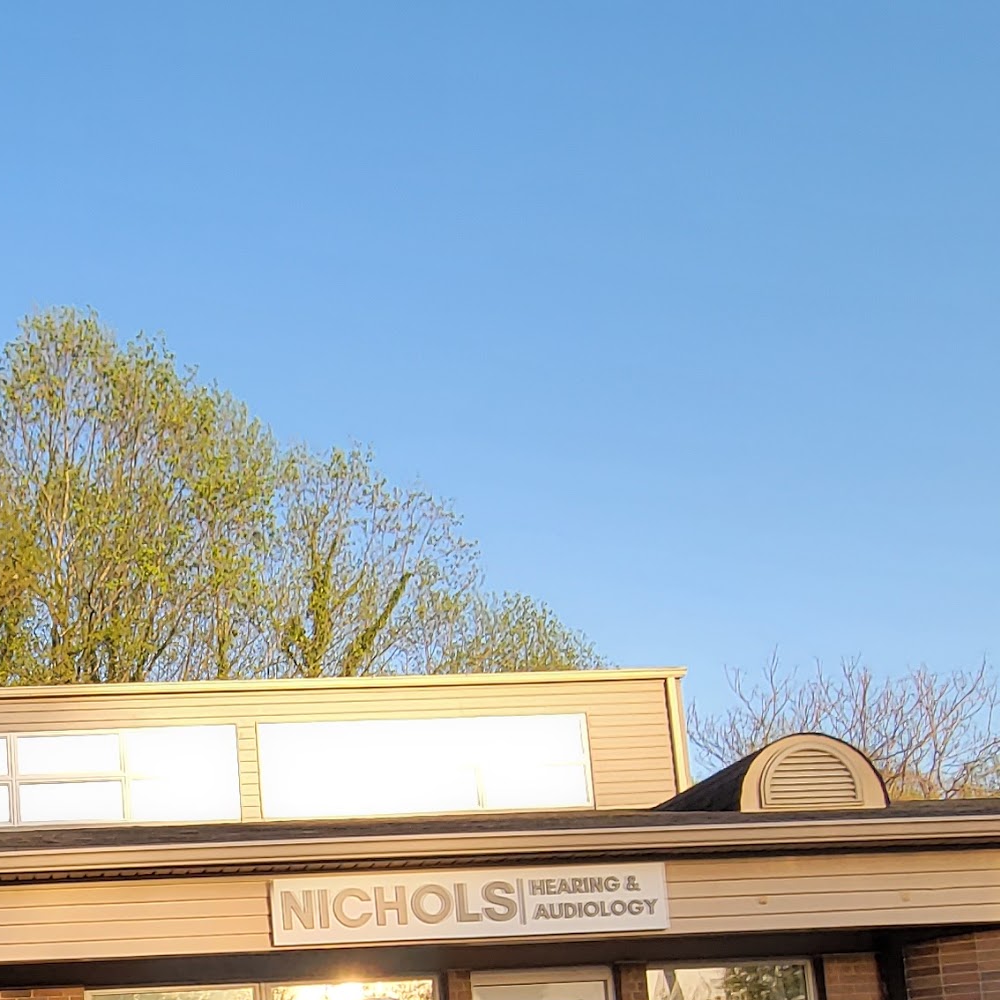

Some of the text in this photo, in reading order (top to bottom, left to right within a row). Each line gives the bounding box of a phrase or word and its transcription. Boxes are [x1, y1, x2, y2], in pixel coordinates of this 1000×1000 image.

[531, 875, 640, 896] HEARING &
[280, 880, 517, 930] NICHOLS
[532, 898, 658, 920] AUDIOLOGY
